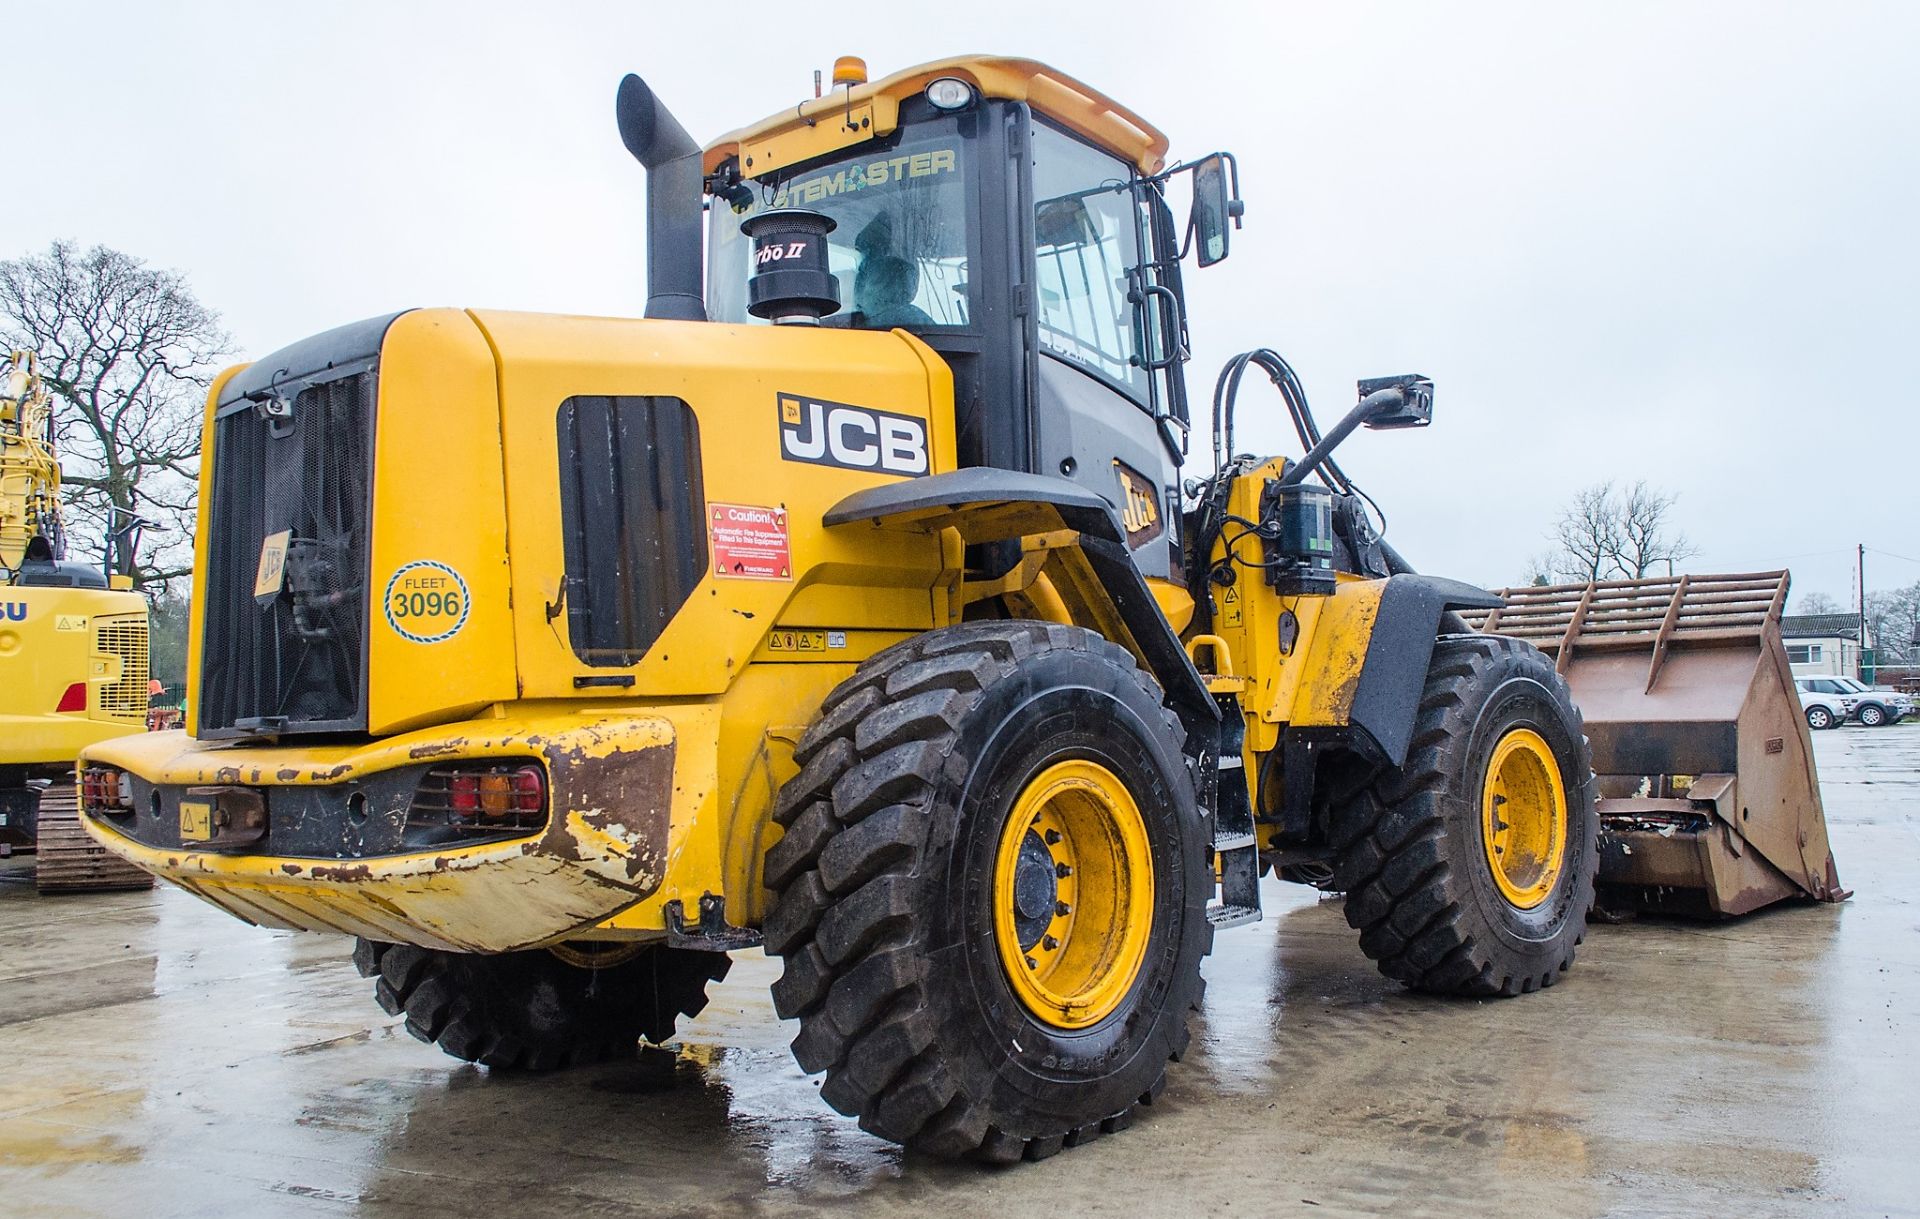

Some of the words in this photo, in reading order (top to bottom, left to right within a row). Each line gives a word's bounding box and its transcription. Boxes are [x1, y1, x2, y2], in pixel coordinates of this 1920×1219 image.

[784, 243, 807, 258] II
[783, 403, 927, 474] JCB
[728, 508, 771, 524] Caution!
[405, 578, 447, 589] FLEET
[394, 592, 459, 618] 3096
